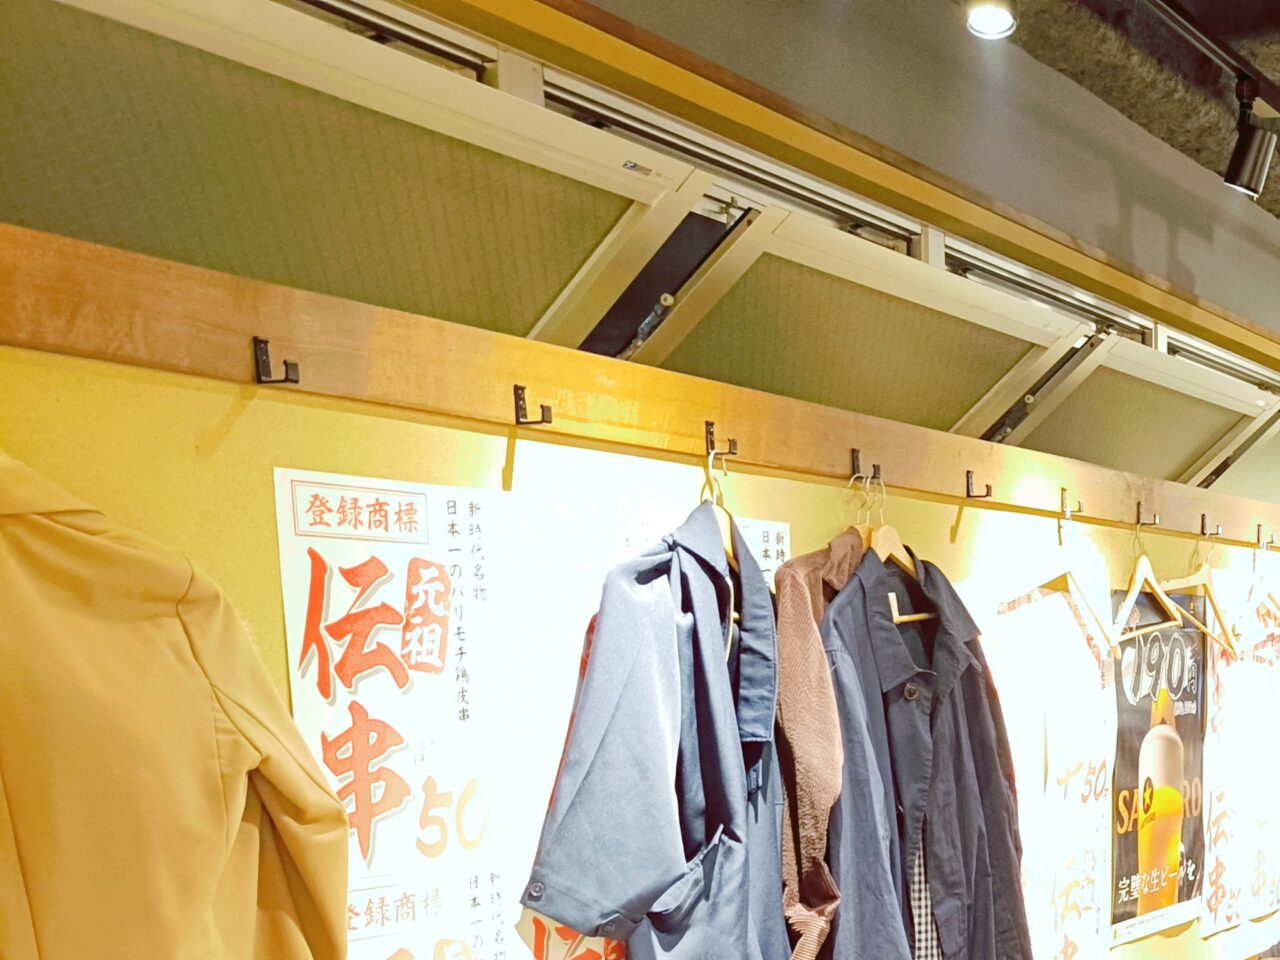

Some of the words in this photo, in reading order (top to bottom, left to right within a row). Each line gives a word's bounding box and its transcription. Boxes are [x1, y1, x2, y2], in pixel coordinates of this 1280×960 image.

[305, 493, 418, 534] 登録商標
[467, 501, 487, 601] 新時代名物
[405, 564, 446, 668] 元祖
[298, 546, 414, 862] 伝串
[1117, 858, 1197, 905] 完璧な生ビールを
